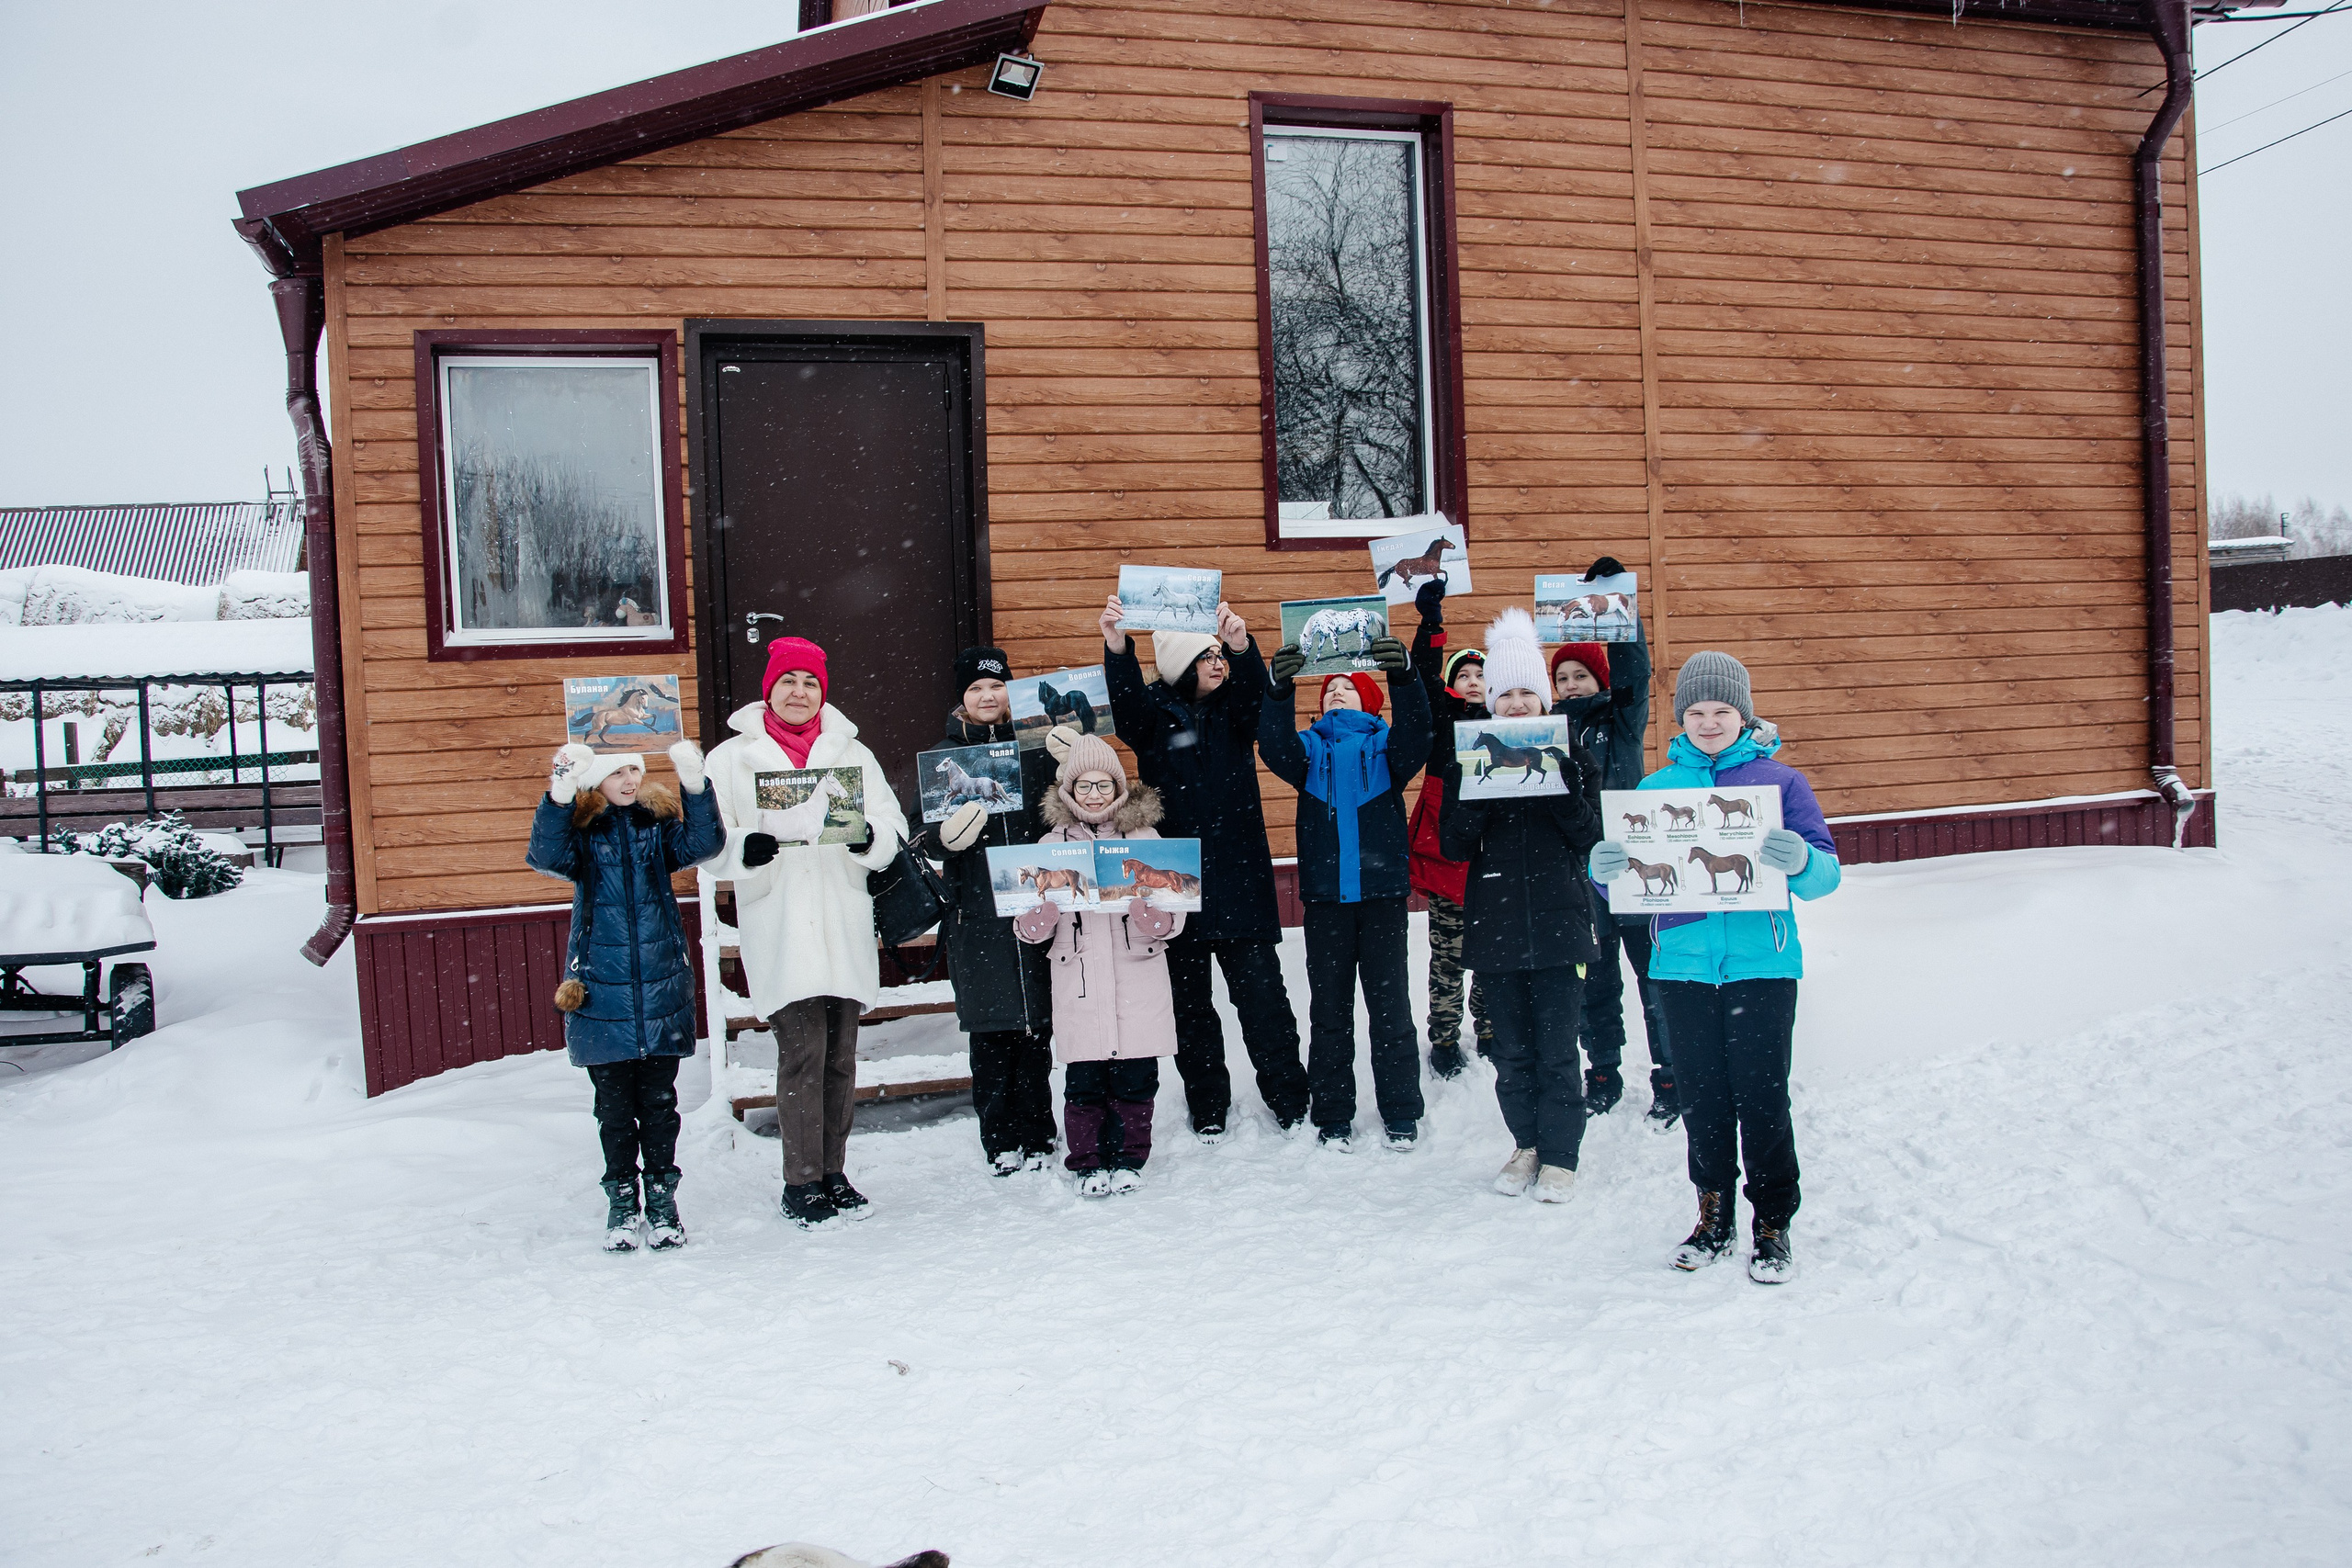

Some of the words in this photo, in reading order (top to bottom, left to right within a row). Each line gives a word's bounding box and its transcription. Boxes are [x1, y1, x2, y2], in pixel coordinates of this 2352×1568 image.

[1376, 542, 1404, 553] Гнедая
[1187, 573, 1212, 582] Серая
[1543, 581, 1566, 589] Пегая
[1351, 659, 1385, 668] Чубар
[1069, 670, 1102, 682] Вороная
[570, 684, 609, 694] Буланая
[989, 749, 1014, 758] Чалая
[759, 776, 818, 787] Изабелловая
[1051, 848, 1088, 857] Соловая
[1099, 846, 1130, 854] Рыжая
